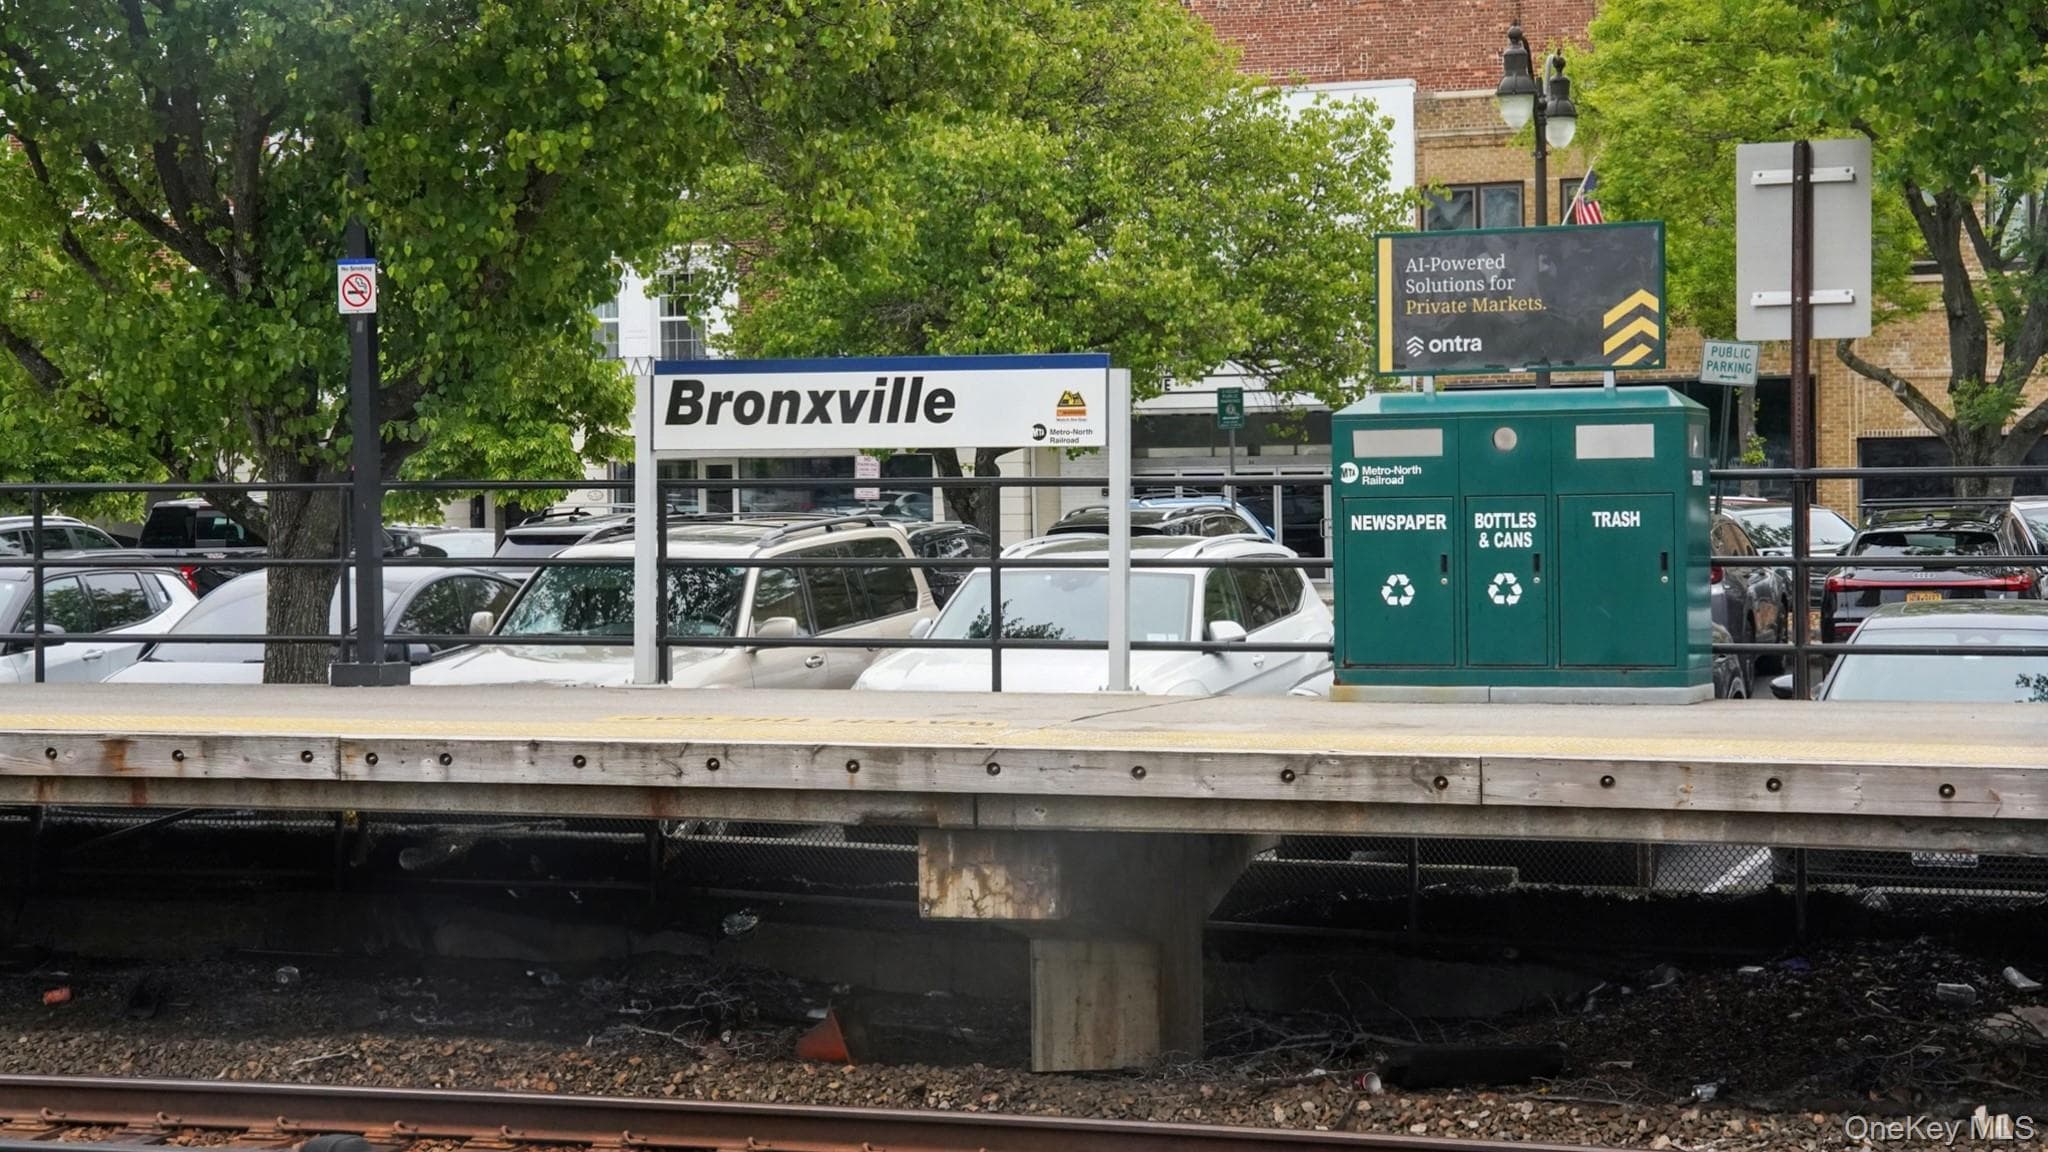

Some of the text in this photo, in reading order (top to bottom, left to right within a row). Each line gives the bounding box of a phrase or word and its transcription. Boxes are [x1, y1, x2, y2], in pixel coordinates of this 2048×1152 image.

[1405, 253, 1506, 273] AI-Powered
[1405, 275, 1516, 294] Solutions for
[1405, 296, 1547, 315] Private Markets.
[1428, 336, 1482, 353] ontra
[1711, 345, 1751, 360] PUBLIC
[1706, 360, 1752, 374] PARKING
[664, 377, 956, 426] Bronxville
[1049, 428, 1093, 436] Metro-North
[1341, 464, 1422, 481] MTA Metro-North
[1362, 475, 1405, 485] Railroad
[1351, 514, 1447, 531] NEWSPAPER
[1474, 512, 1537, 529] BOTTLES
[1592, 511, 1640, 528] TRASH
[1479, 531, 1533, 548] & CANS
